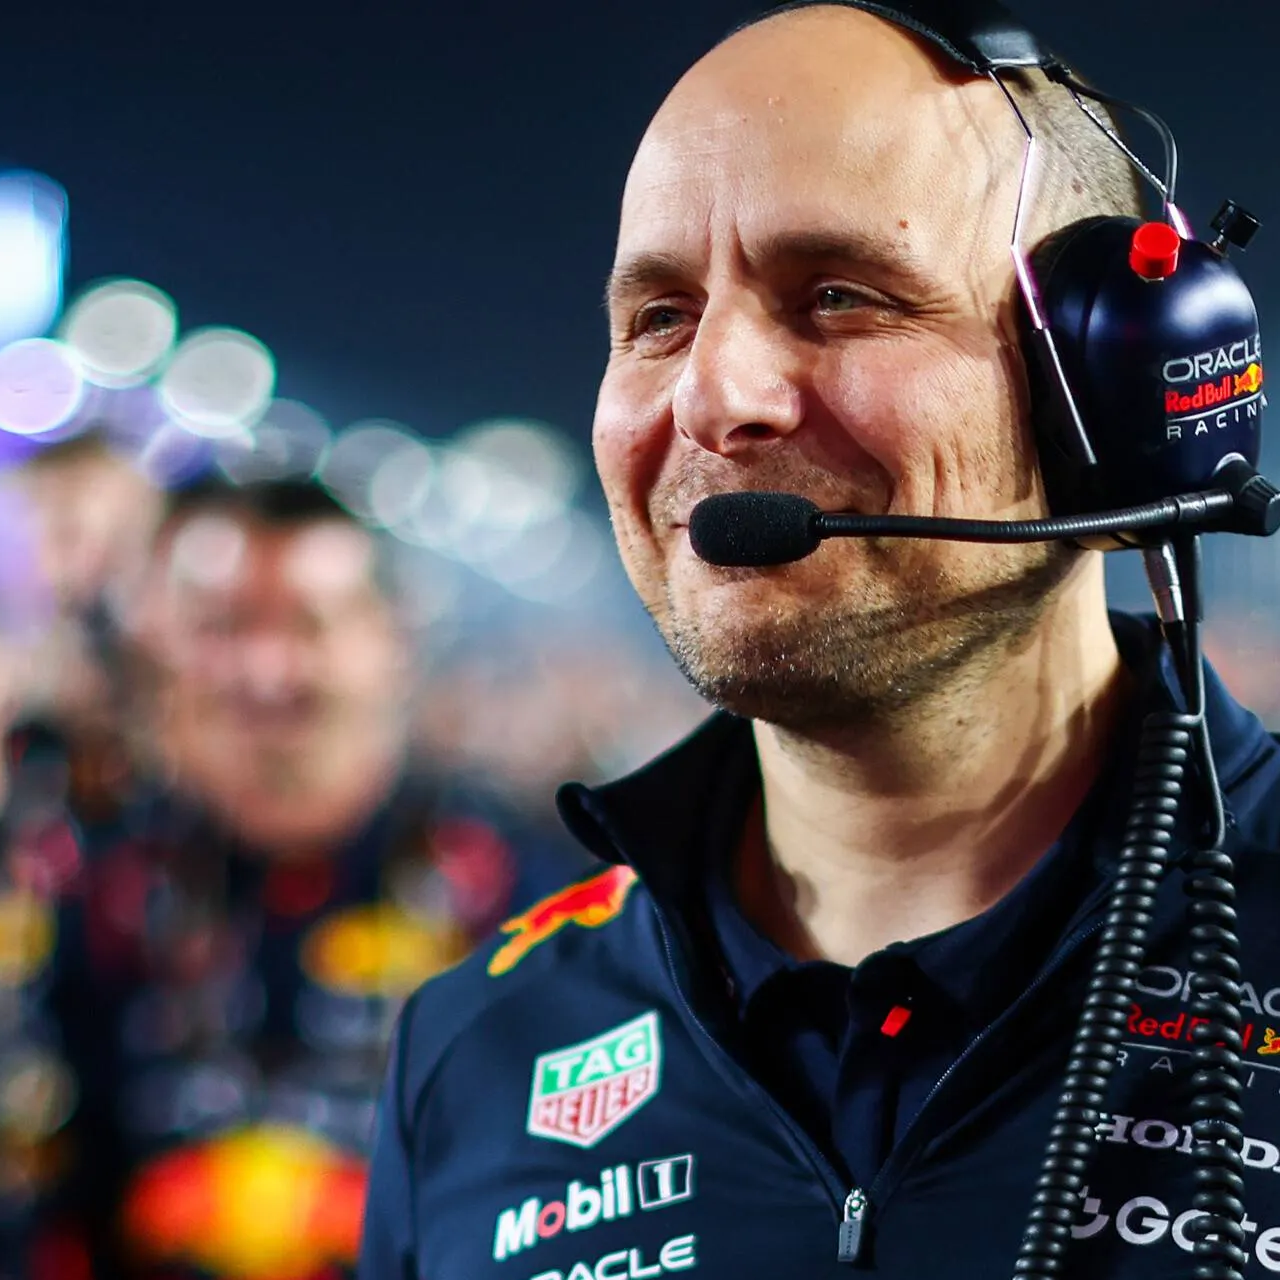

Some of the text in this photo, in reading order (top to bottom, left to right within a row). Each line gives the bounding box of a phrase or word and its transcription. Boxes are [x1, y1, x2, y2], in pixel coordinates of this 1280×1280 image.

[547, 1030, 644, 1089] TAG
[534, 1066, 651, 1136] HEUER
[492, 1164, 632, 1261] Mobil
